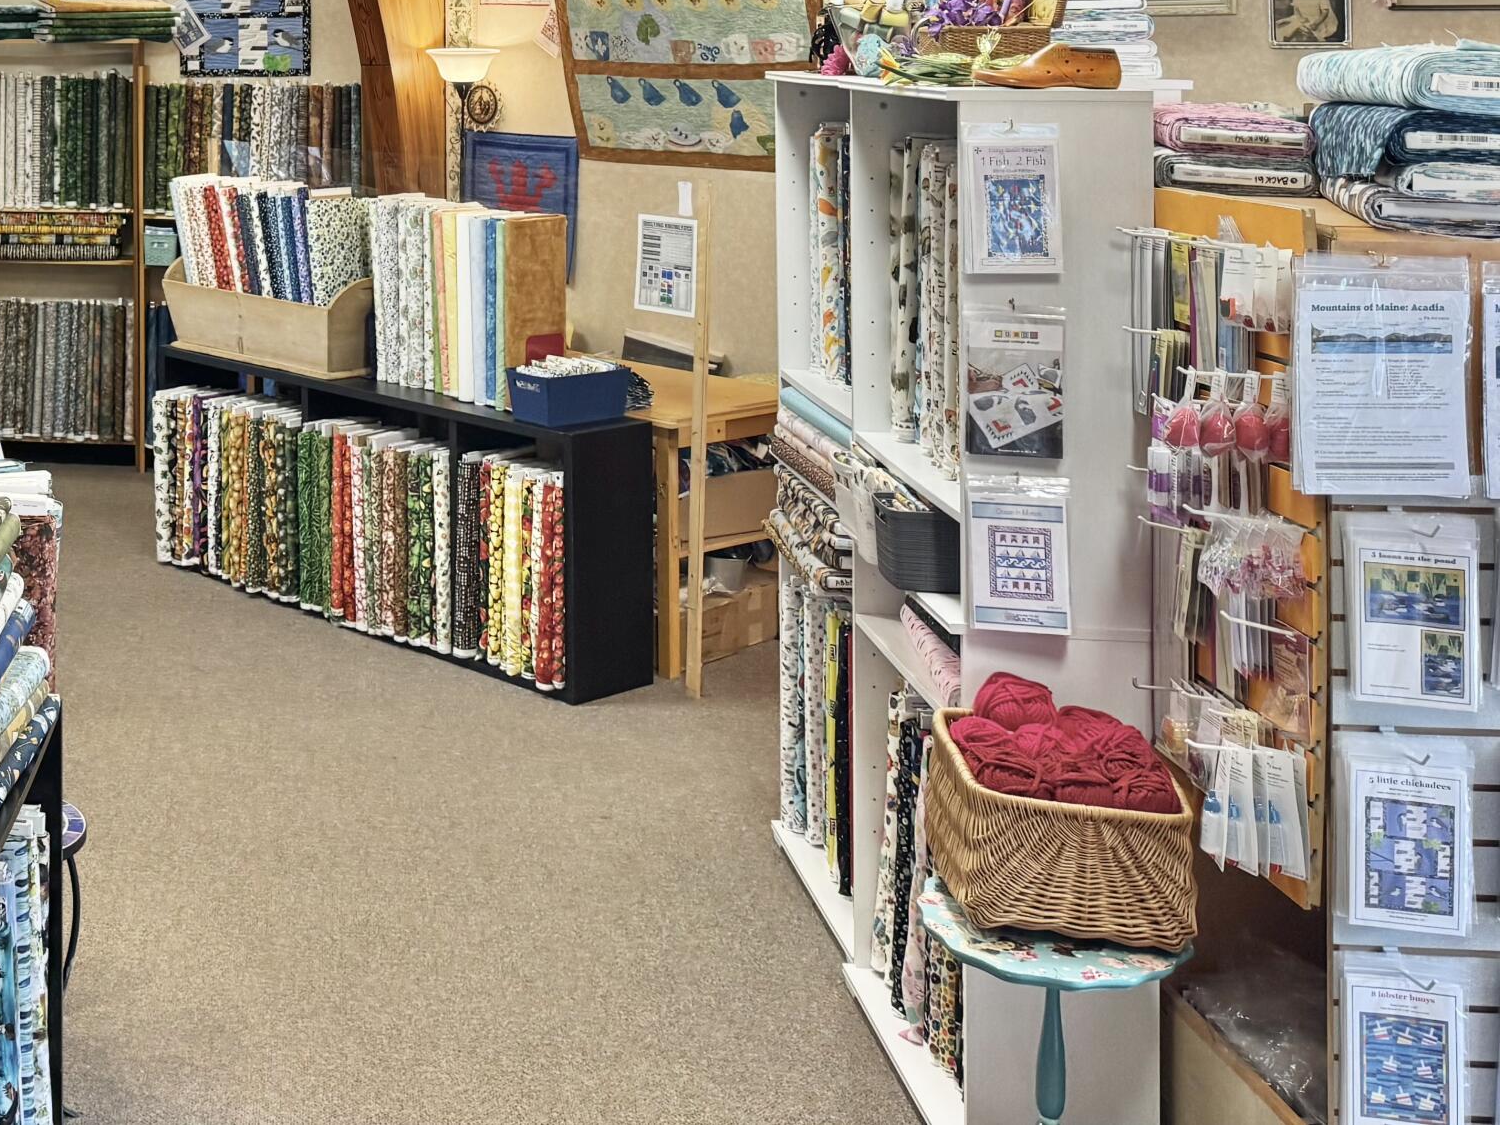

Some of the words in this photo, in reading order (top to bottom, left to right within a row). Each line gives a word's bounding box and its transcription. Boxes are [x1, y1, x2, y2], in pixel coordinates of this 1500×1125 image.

[1311, 303, 1361, 313] Mountains
[1363, 303, 1374, 312] of
[1376, 303, 1409, 312] Maine:
[1411, 303, 1445, 312] Acadia
[1418, 555, 1431, 563] the
[1377, 775, 1399, 786] little
[1400, 777, 1452, 791] chickadees
[1378, 990, 1408, 1001] lobster
